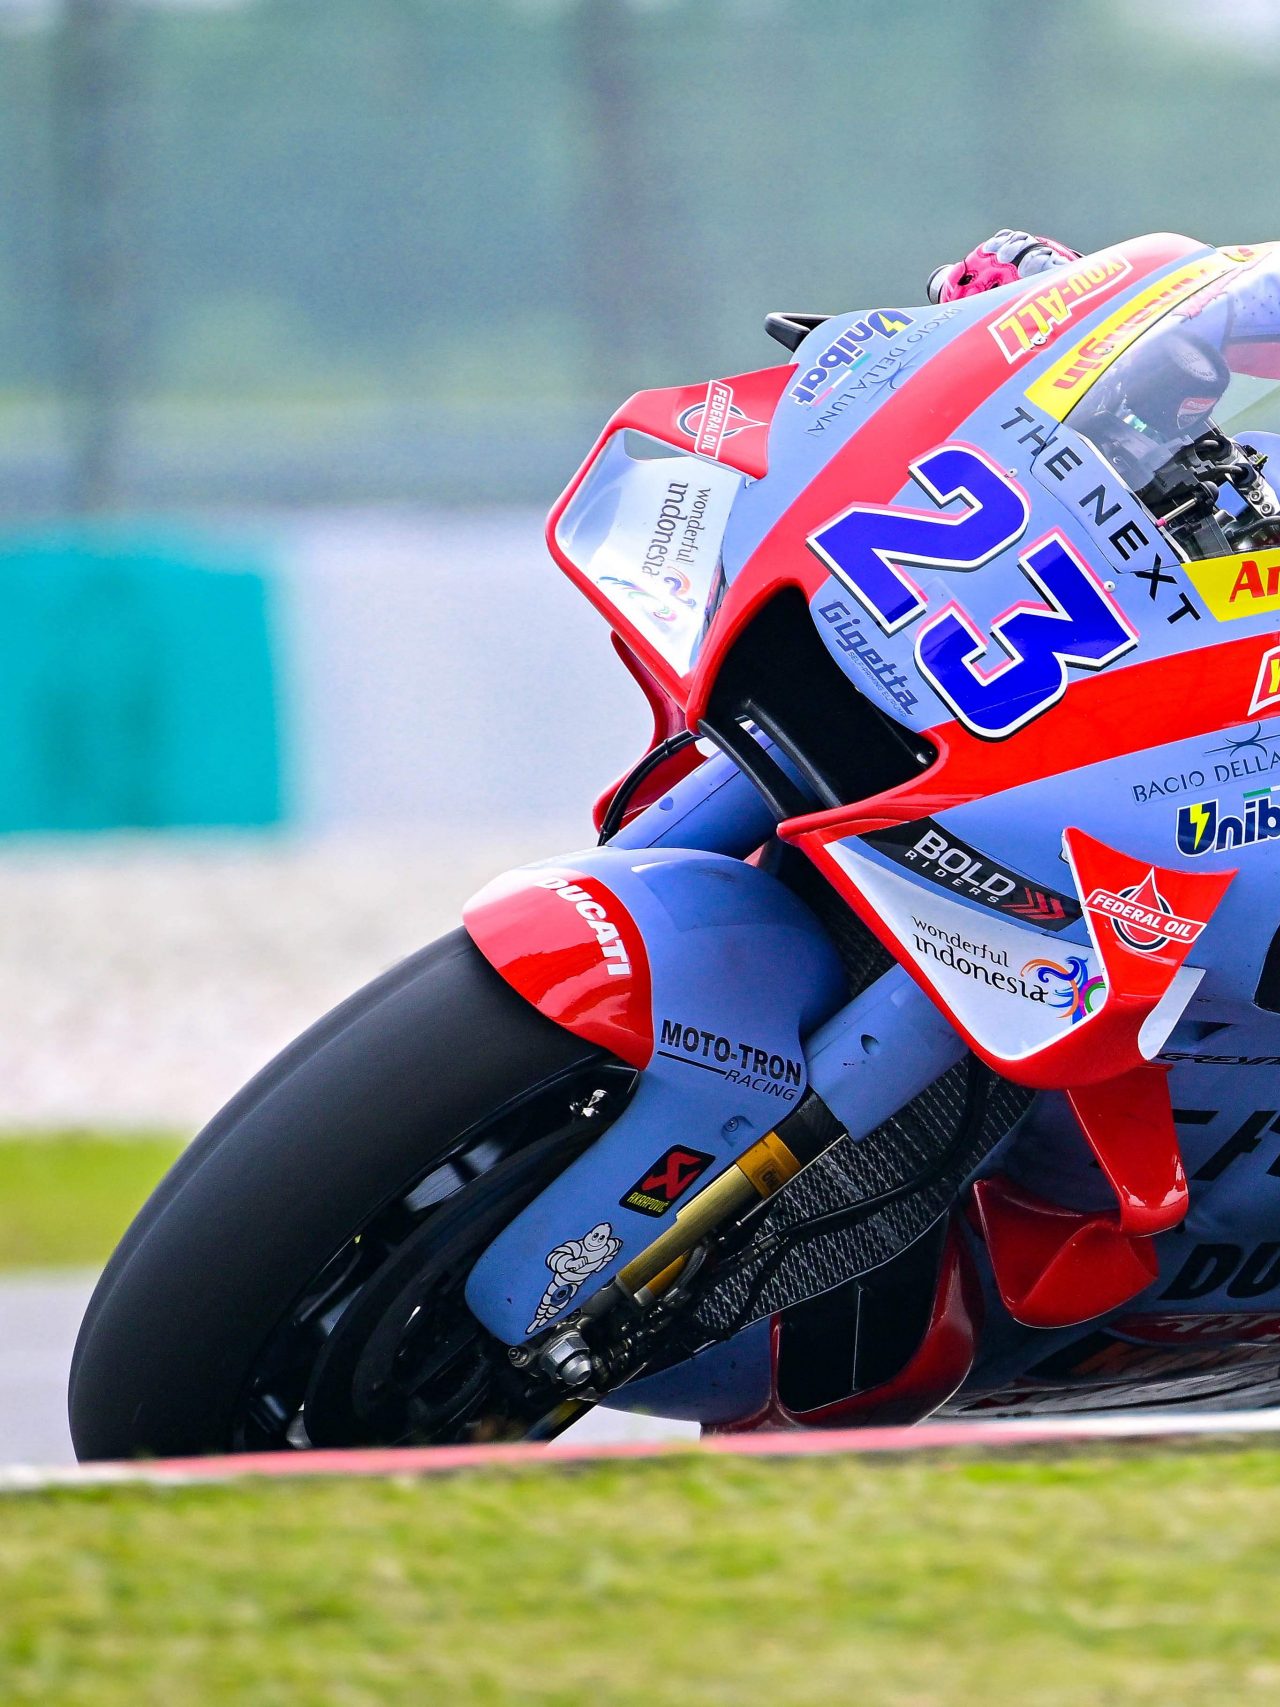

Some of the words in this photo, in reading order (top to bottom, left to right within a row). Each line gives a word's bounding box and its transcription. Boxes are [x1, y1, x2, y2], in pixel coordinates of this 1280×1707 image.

[789, 308, 916, 405] Unibat
[850, 347, 906, 390] DELLA
[700, 434, 717, 450] OIL
[705, 386, 728, 433] FEDERAL
[807, 393, 857, 433] LUNA
[640, 482, 689, 577] indonesia
[676, 488, 711, 563] wonderful
[1000, 406, 1083, 482] THE
[1078, 484, 1202, 626] NEXT
[806, 442, 1138, 738] 23
[818, 600, 919, 717] Gigetta
[1132, 770, 1205, 803] BACIO
[904, 850, 1000, 904] RIDERS
[913, 829, 1016, 898] BOLD
[537, 876, 631, 976] DUCATI
[912, 915, 1009, 968] wonderful
[1092, 893, 1161, 928] FEDERAL
[1163, 919, 1192, 938] OIL
[913, 933, 1048, 1004] indonesia
[660, 1019, 801, 1087] MOTO-TRON
[725, 1069, 799, 1101] RACING
